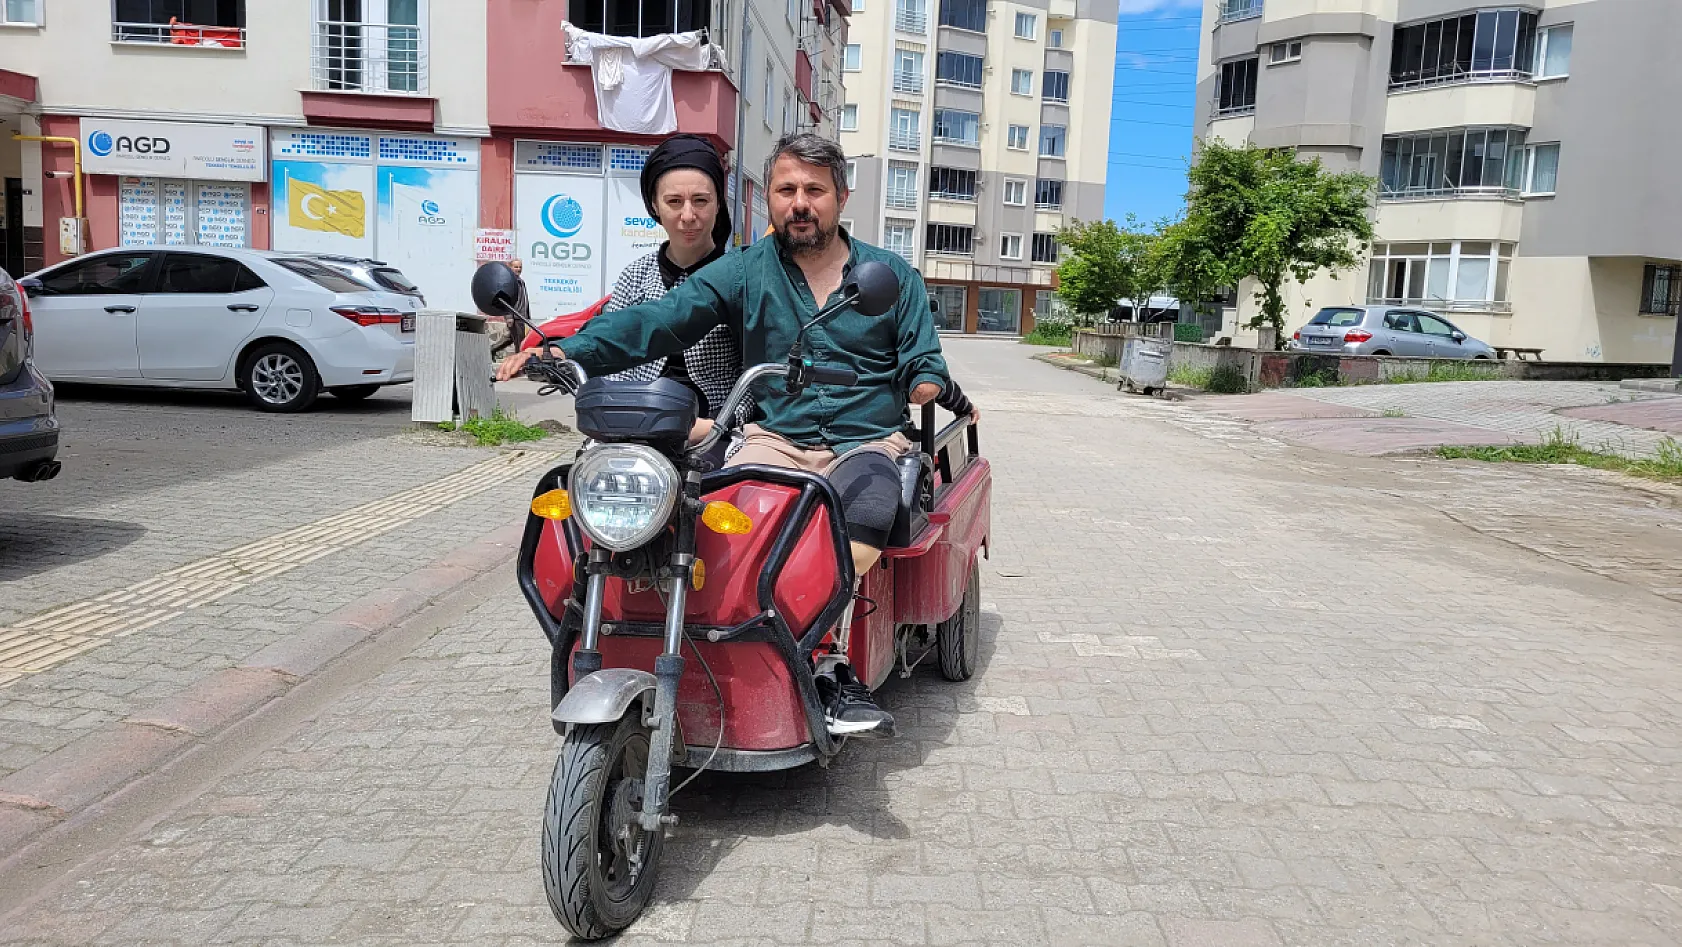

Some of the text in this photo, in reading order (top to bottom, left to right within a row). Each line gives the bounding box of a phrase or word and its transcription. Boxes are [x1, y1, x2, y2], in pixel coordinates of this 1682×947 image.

[116, 136, 171, 154] AGD
[418, 216, 446, 225] AGD
[531, 241, 592, 261] AGD
